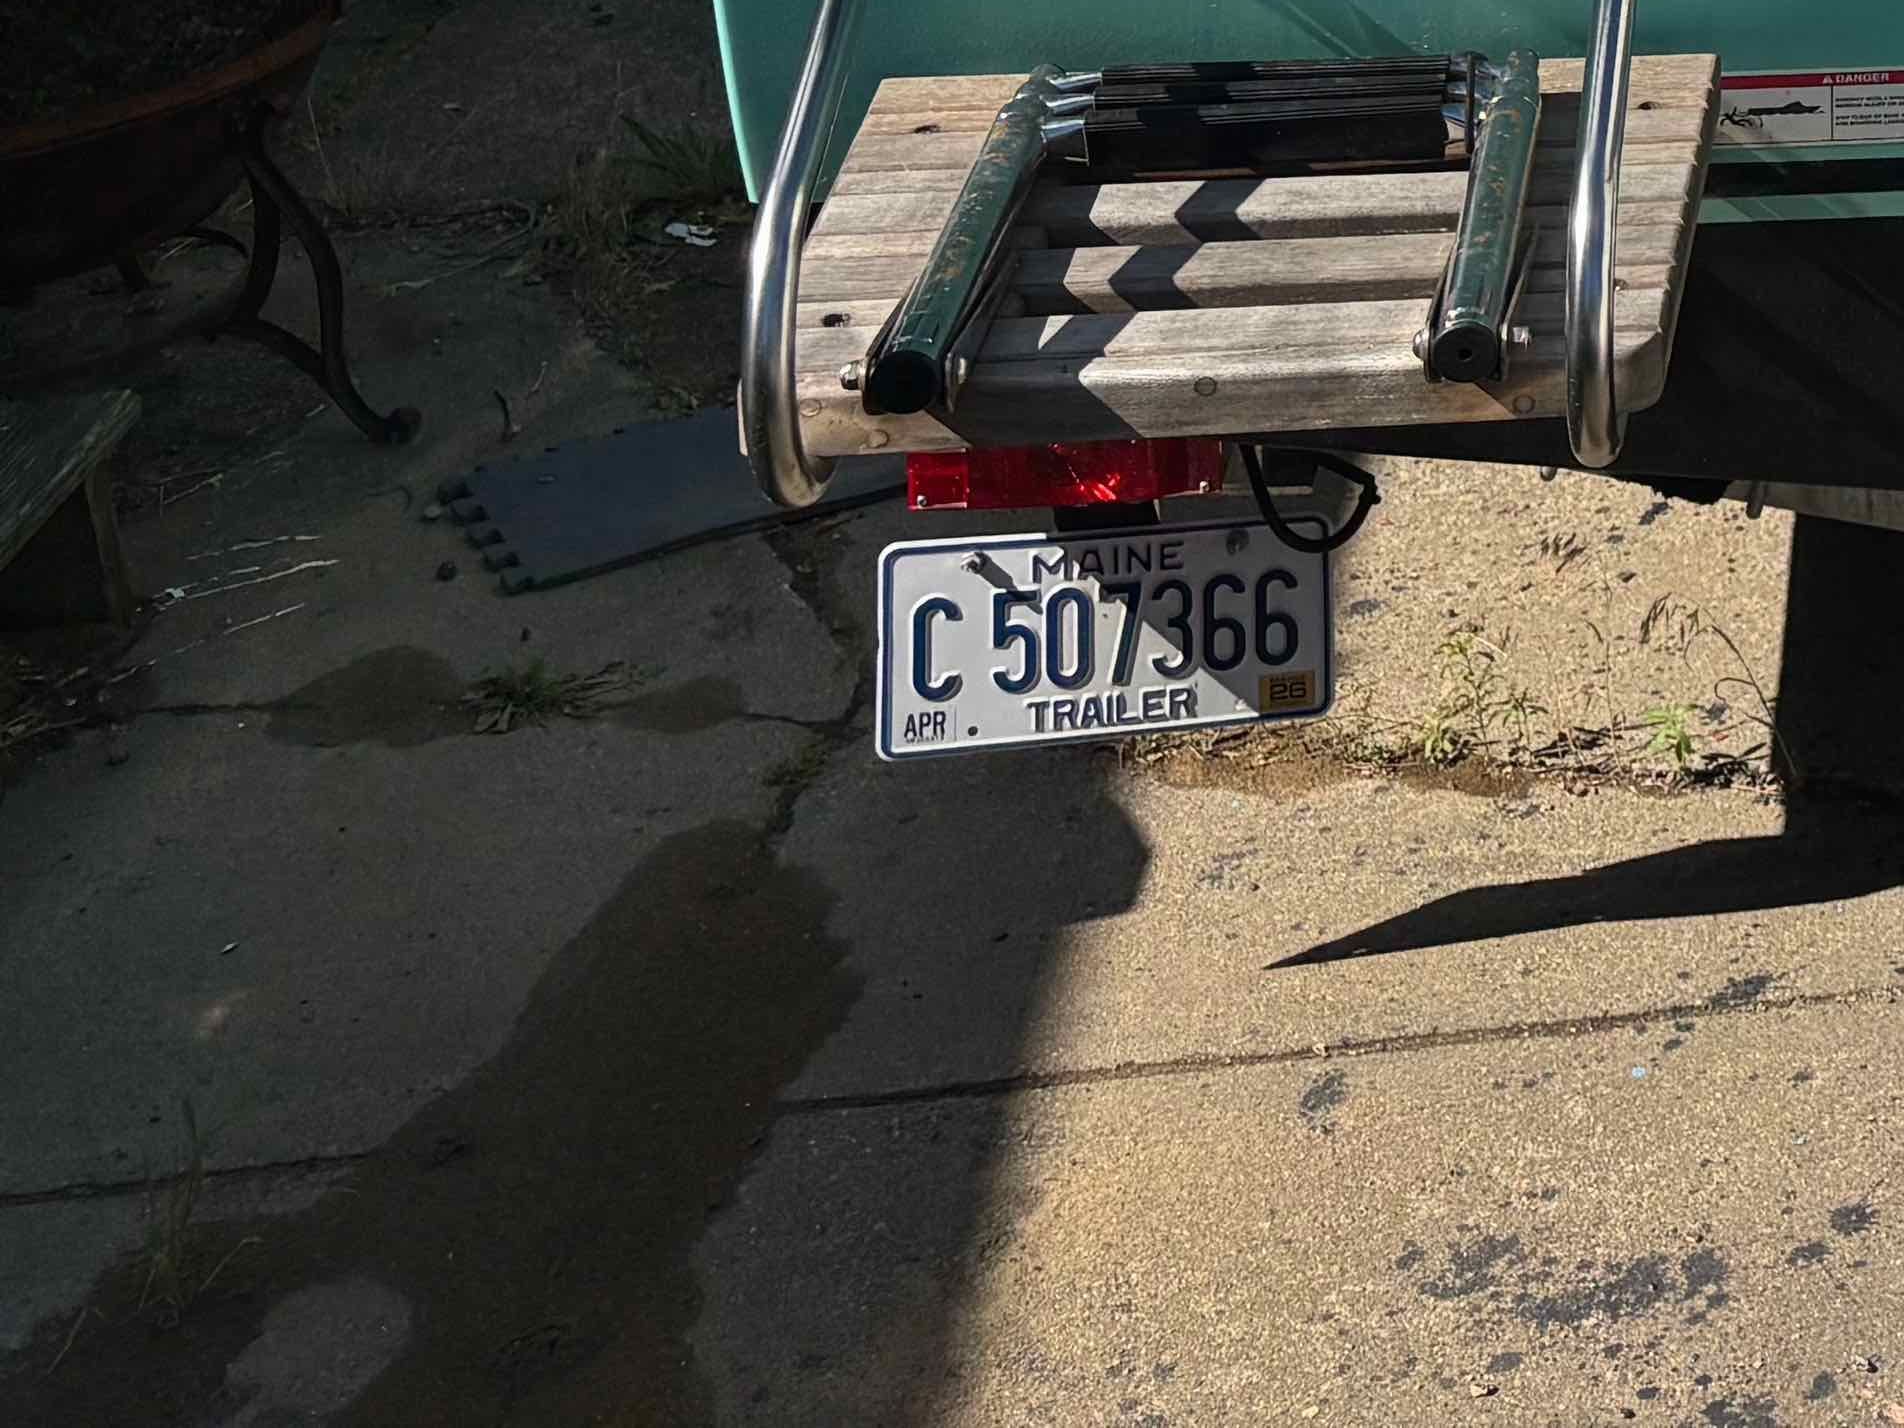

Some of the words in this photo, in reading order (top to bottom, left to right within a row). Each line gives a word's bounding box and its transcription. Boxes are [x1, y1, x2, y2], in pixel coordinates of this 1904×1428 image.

[1835, 71, 1890, 84] DANGER
[1031, 540, 1184, 584] MAINE
[912, 596, 964, 702] C
[992, 569, 1299, 694] 507366
[1269, 680, 1307, 701] 26
[904, 710, 947, 741] APR
[1026, 687, 1199, 733] TRAILER
